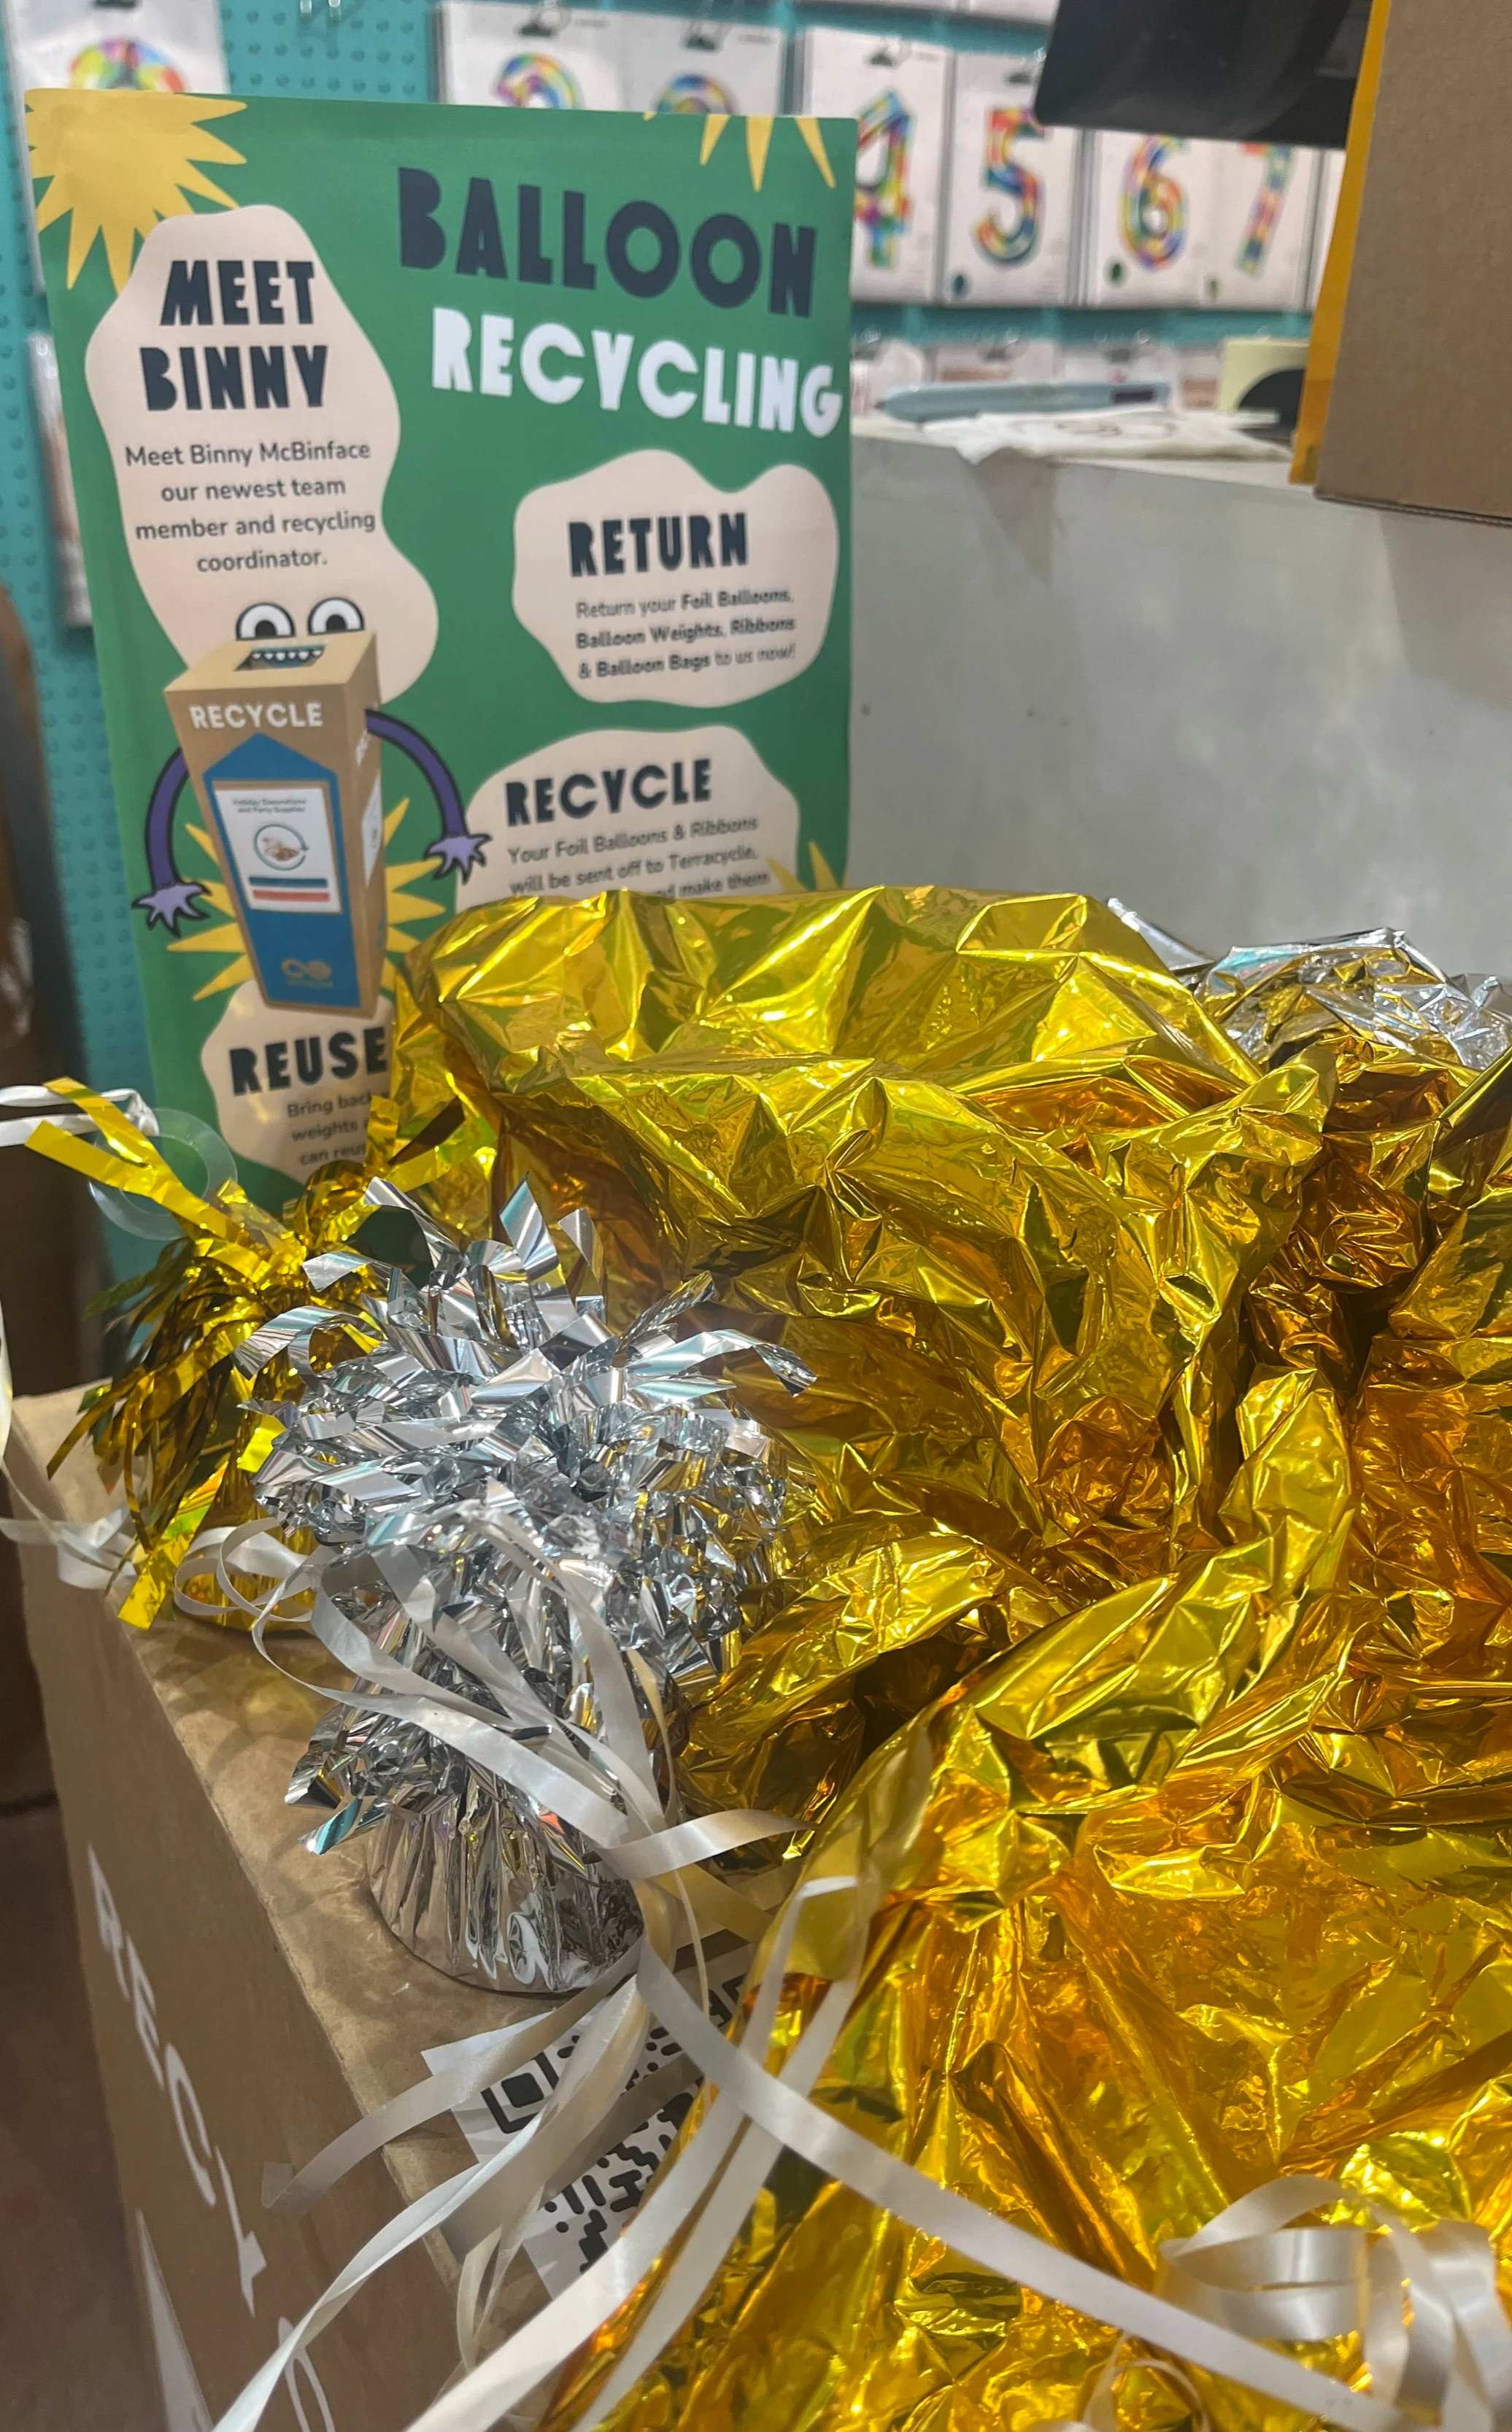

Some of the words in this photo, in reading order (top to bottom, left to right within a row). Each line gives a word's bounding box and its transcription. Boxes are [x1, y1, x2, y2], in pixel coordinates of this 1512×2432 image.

[398, 166, 817, 319] BALLOON
[160, 260, 315, 325] MEET
[139, 344, 328, 412] BINNY
[431, 306, 843, 439] RECYCLING
[125, 446, 185, 466] Meet
[190, 444, 252, 466] Binny
[259, 440, 371, 463] McBinface
[161, 485, 198, 502] our
[205, 479, 286, 501] newest
[290, 479, 347, 497] team
[135, 518, 228, 541] member
[235, 514, 276, 535] and
[282, 510, 377, 536] recycling
[568, 512, 747, 578] RETURN
[196, 549, 328, 574] coordinator.
[576, 600, 636, 619] Return
[638, 599, 676, 617] your
[679, 592, 713, 611] Foil
[576, 630, 646, 649] Balloon
[730, 617, 796, 635] Ribbons
[577, 662, 591, 679] &
[595, 659, 666, 677] Balloon
[668, 653, 711, 672] Bags
[714, 651, 733, 665] to
[734, 650, 754, 664] us
[188, 701, 323, 730] RECYCLE
[505, 757, 713, 827] RECYCLE
[507, 845, 550, 865] Your
[555, 838, 589, 857] Foil
[593, 829, 669, 853] Balloons
[673, 822, 686, 841] &
[690, 816, 759, 838] Ribbons
[509, 873, 544, 895] will
[548, 873, 571, 889] be
[575, 865, 614, 885] sent
[617, 858, 643, 879] off
[644, 858, 664, 873] to
[678, 877, 724, 897] make
[727, 870, 771, 889] them
[229, 1026, 387, 1095] REUSE
[287, 1100, 333, 1117] Bring
[292, 1118, 358, 1141] weights
[300, 1152, 328, 1165] can
